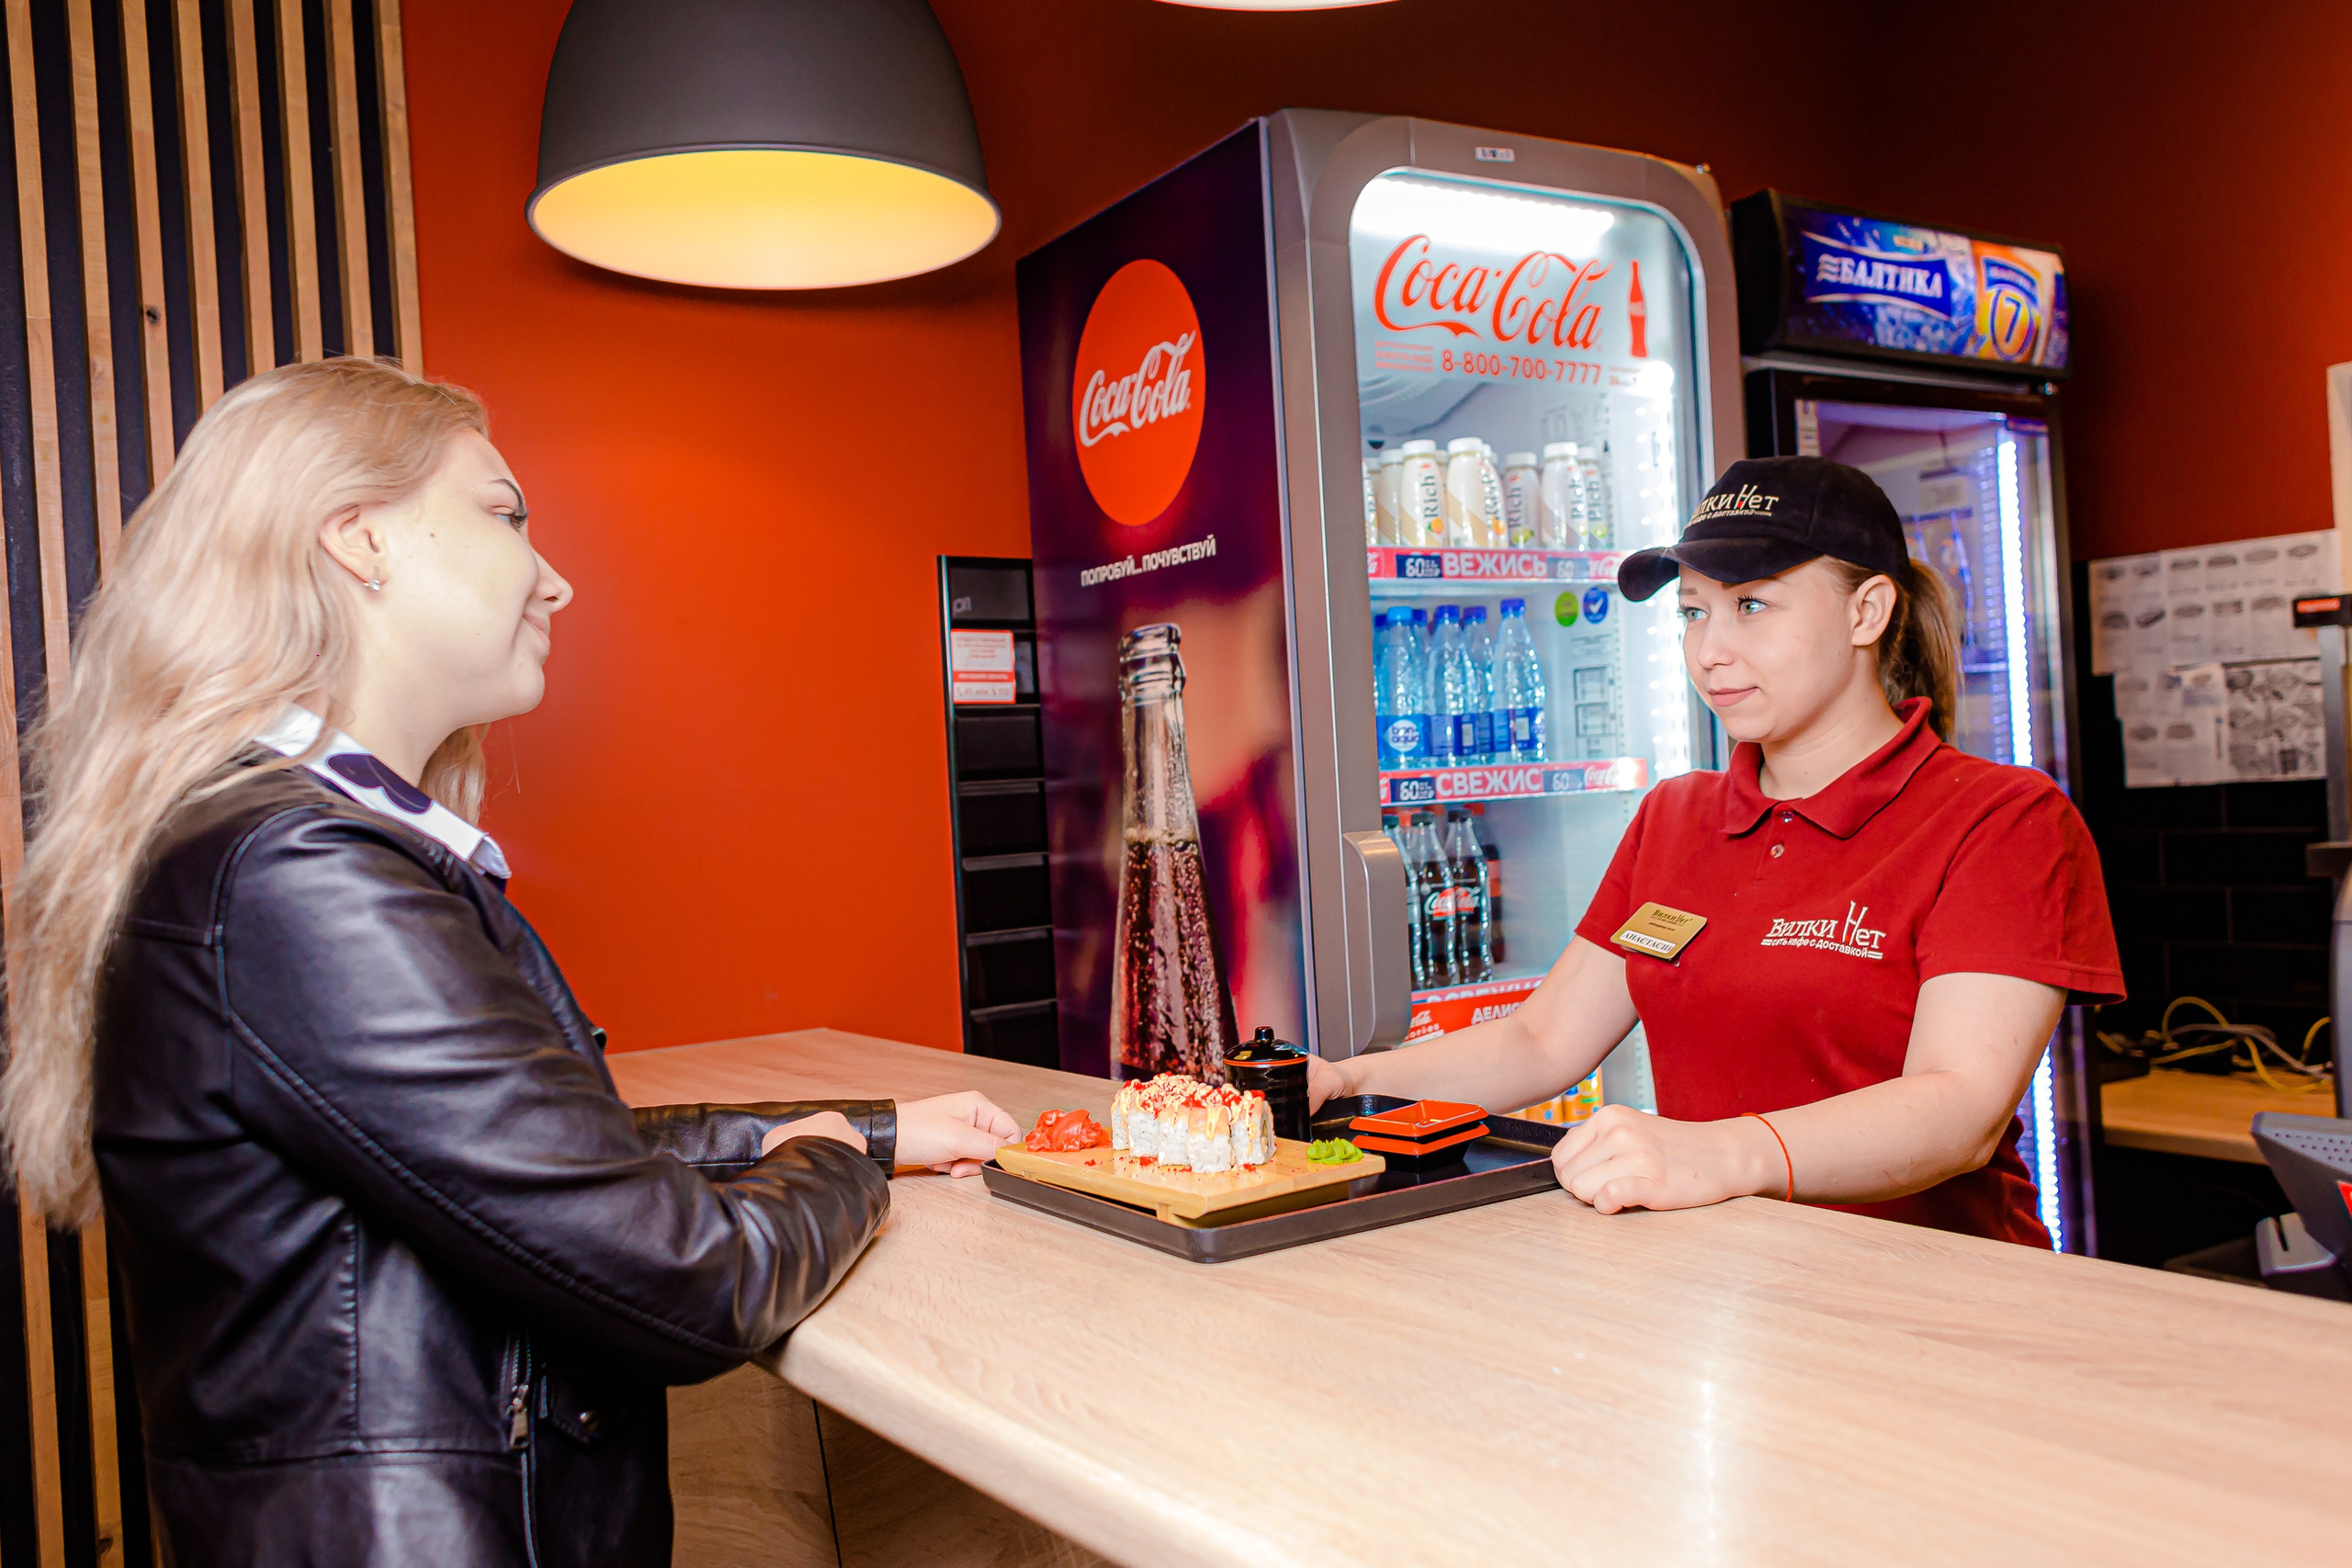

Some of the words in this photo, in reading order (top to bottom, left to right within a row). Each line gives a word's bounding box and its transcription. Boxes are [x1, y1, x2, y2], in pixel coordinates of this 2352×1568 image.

[1374, 234, 1614, 351] Coca-Cola
[1838, 256, 1943, 299] БАЛТИКА
[2004, 295, 2021, 344] 7
[1442, 349, 1601, 385] 8-800-700-7777
[1080, 330, 1196, 447] Coca-Cola
[1420, 475, 1439, 518] Rich
[1405, 557, 1425, 578] 60
[1410, 551, 1547, 578] ВЕЖИСЬ
[1399, 780, 1419, 801] 60
[1424, 766, 1544, 797] СВЕЖИС
[1552, 772, 1570, 791] 60
[1815, 939, 1869, 959] доставкой
[1471, 1000, 1524, 1026] ДЕЛИС
